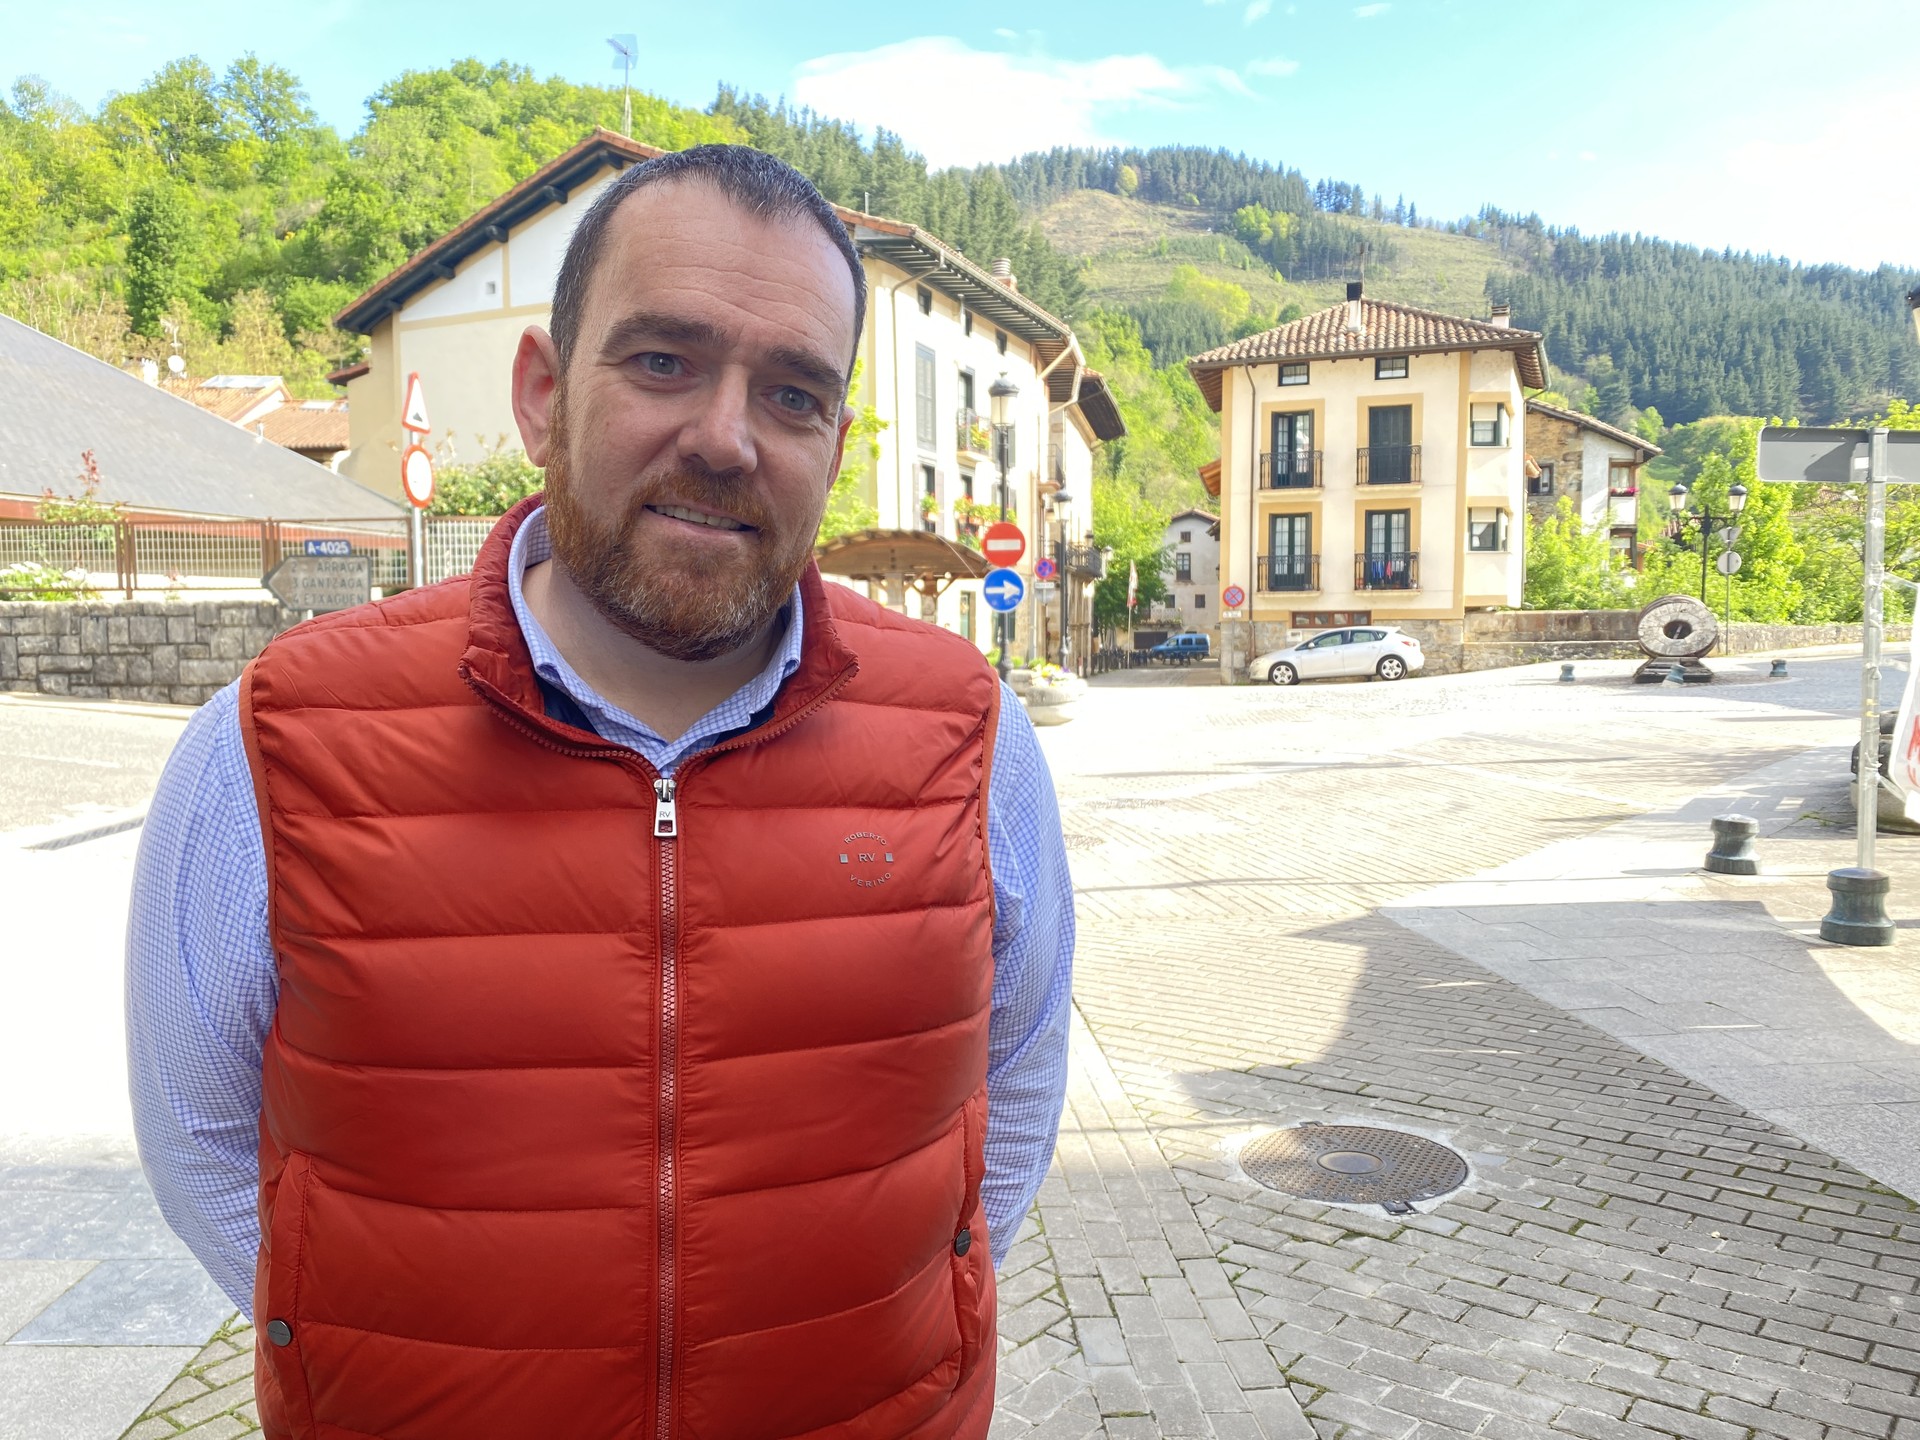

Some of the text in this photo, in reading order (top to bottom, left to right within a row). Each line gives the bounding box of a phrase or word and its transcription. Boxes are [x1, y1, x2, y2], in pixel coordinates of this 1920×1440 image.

[307, 541, 350, 554] A-4025
[291, 561, 364, 573] 2 ARRAGA
[302, 577, 363, 589] GANTZAGA
[304, 593, 364, 605] ETXAGUEN
[659, 810, 671, 818] RV
[844, 832, 887, 845] ROBERTO
[858, 853, 876, 862] RV
[850, 872, 891, 887] VERINO
